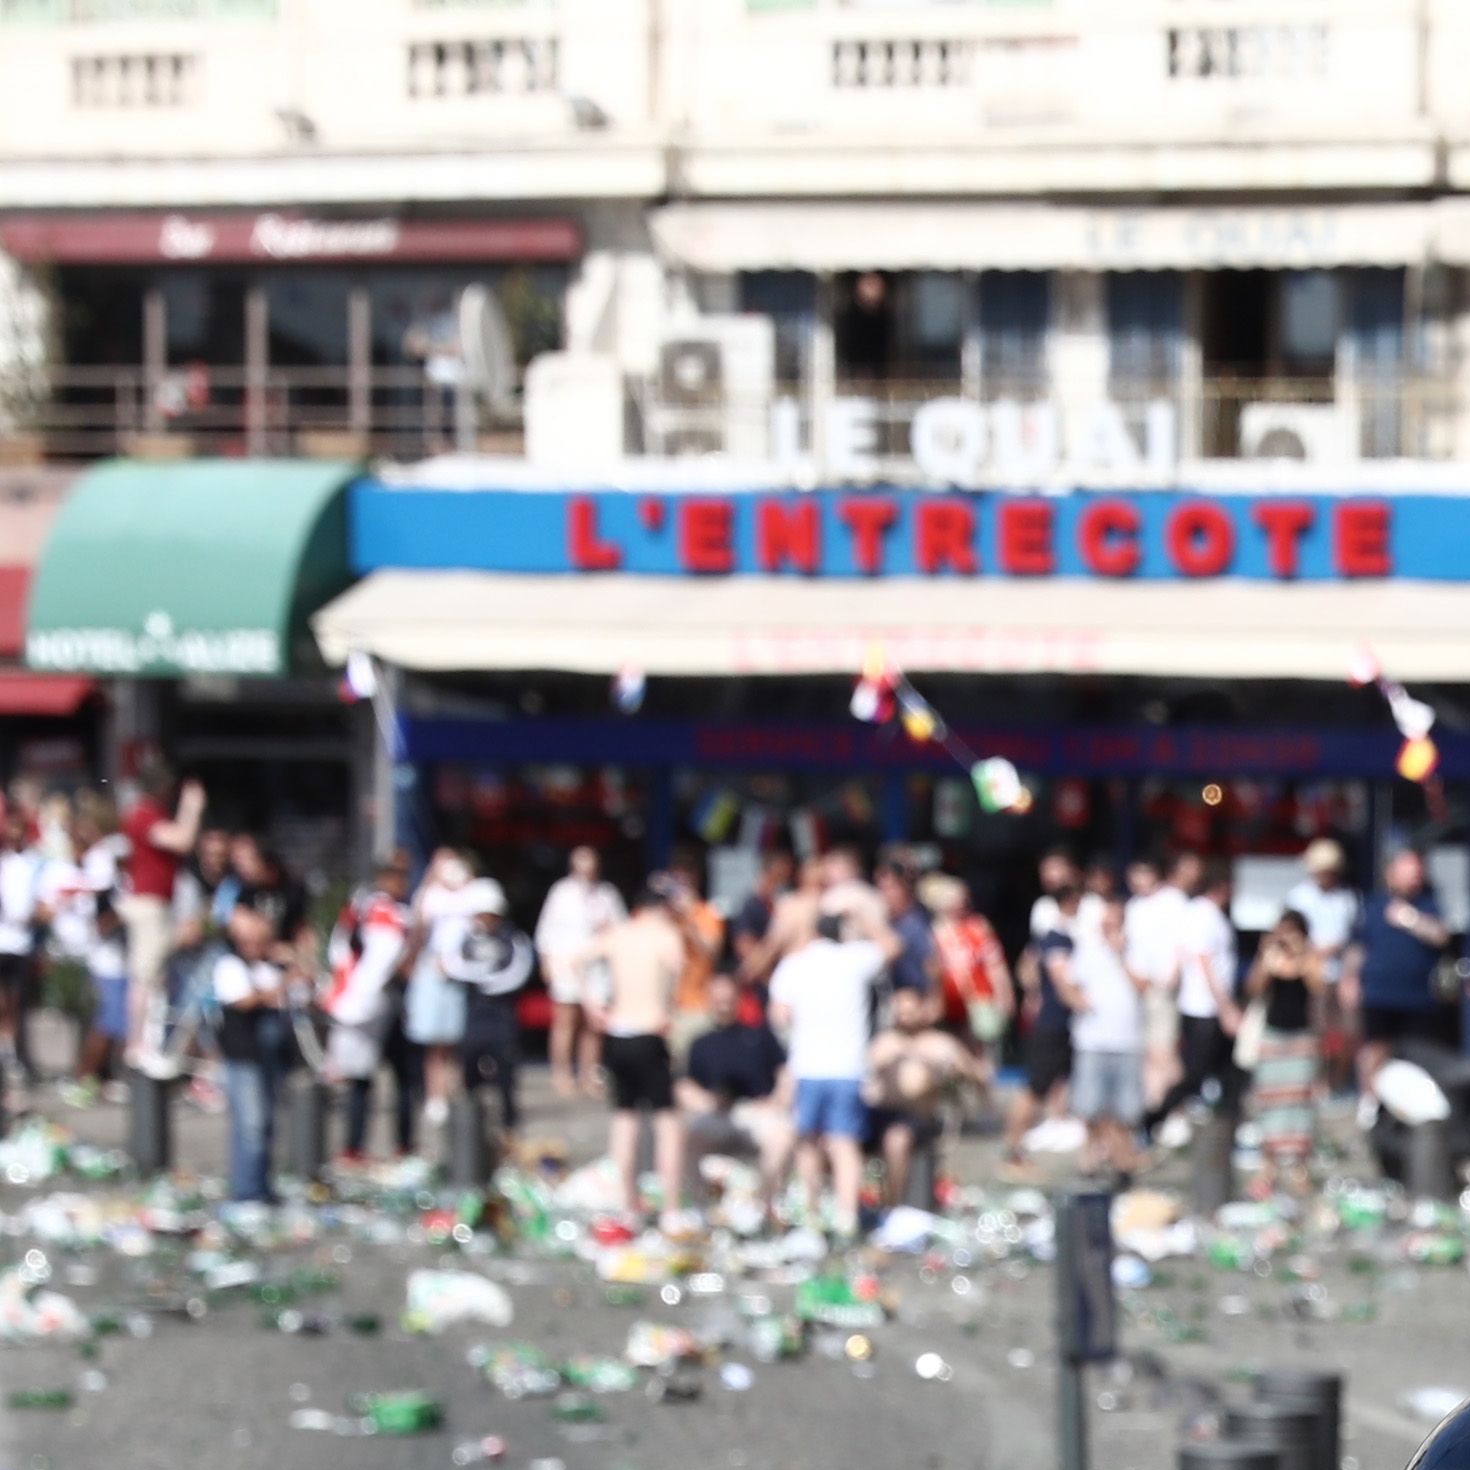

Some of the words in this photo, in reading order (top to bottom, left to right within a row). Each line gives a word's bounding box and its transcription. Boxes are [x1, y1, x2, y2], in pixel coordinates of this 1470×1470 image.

[774, 396, 880, 482] LE
[910, 396, 1177, 482] QUAI
[567, 494, 1393, 582] L'ENTRECOTE
